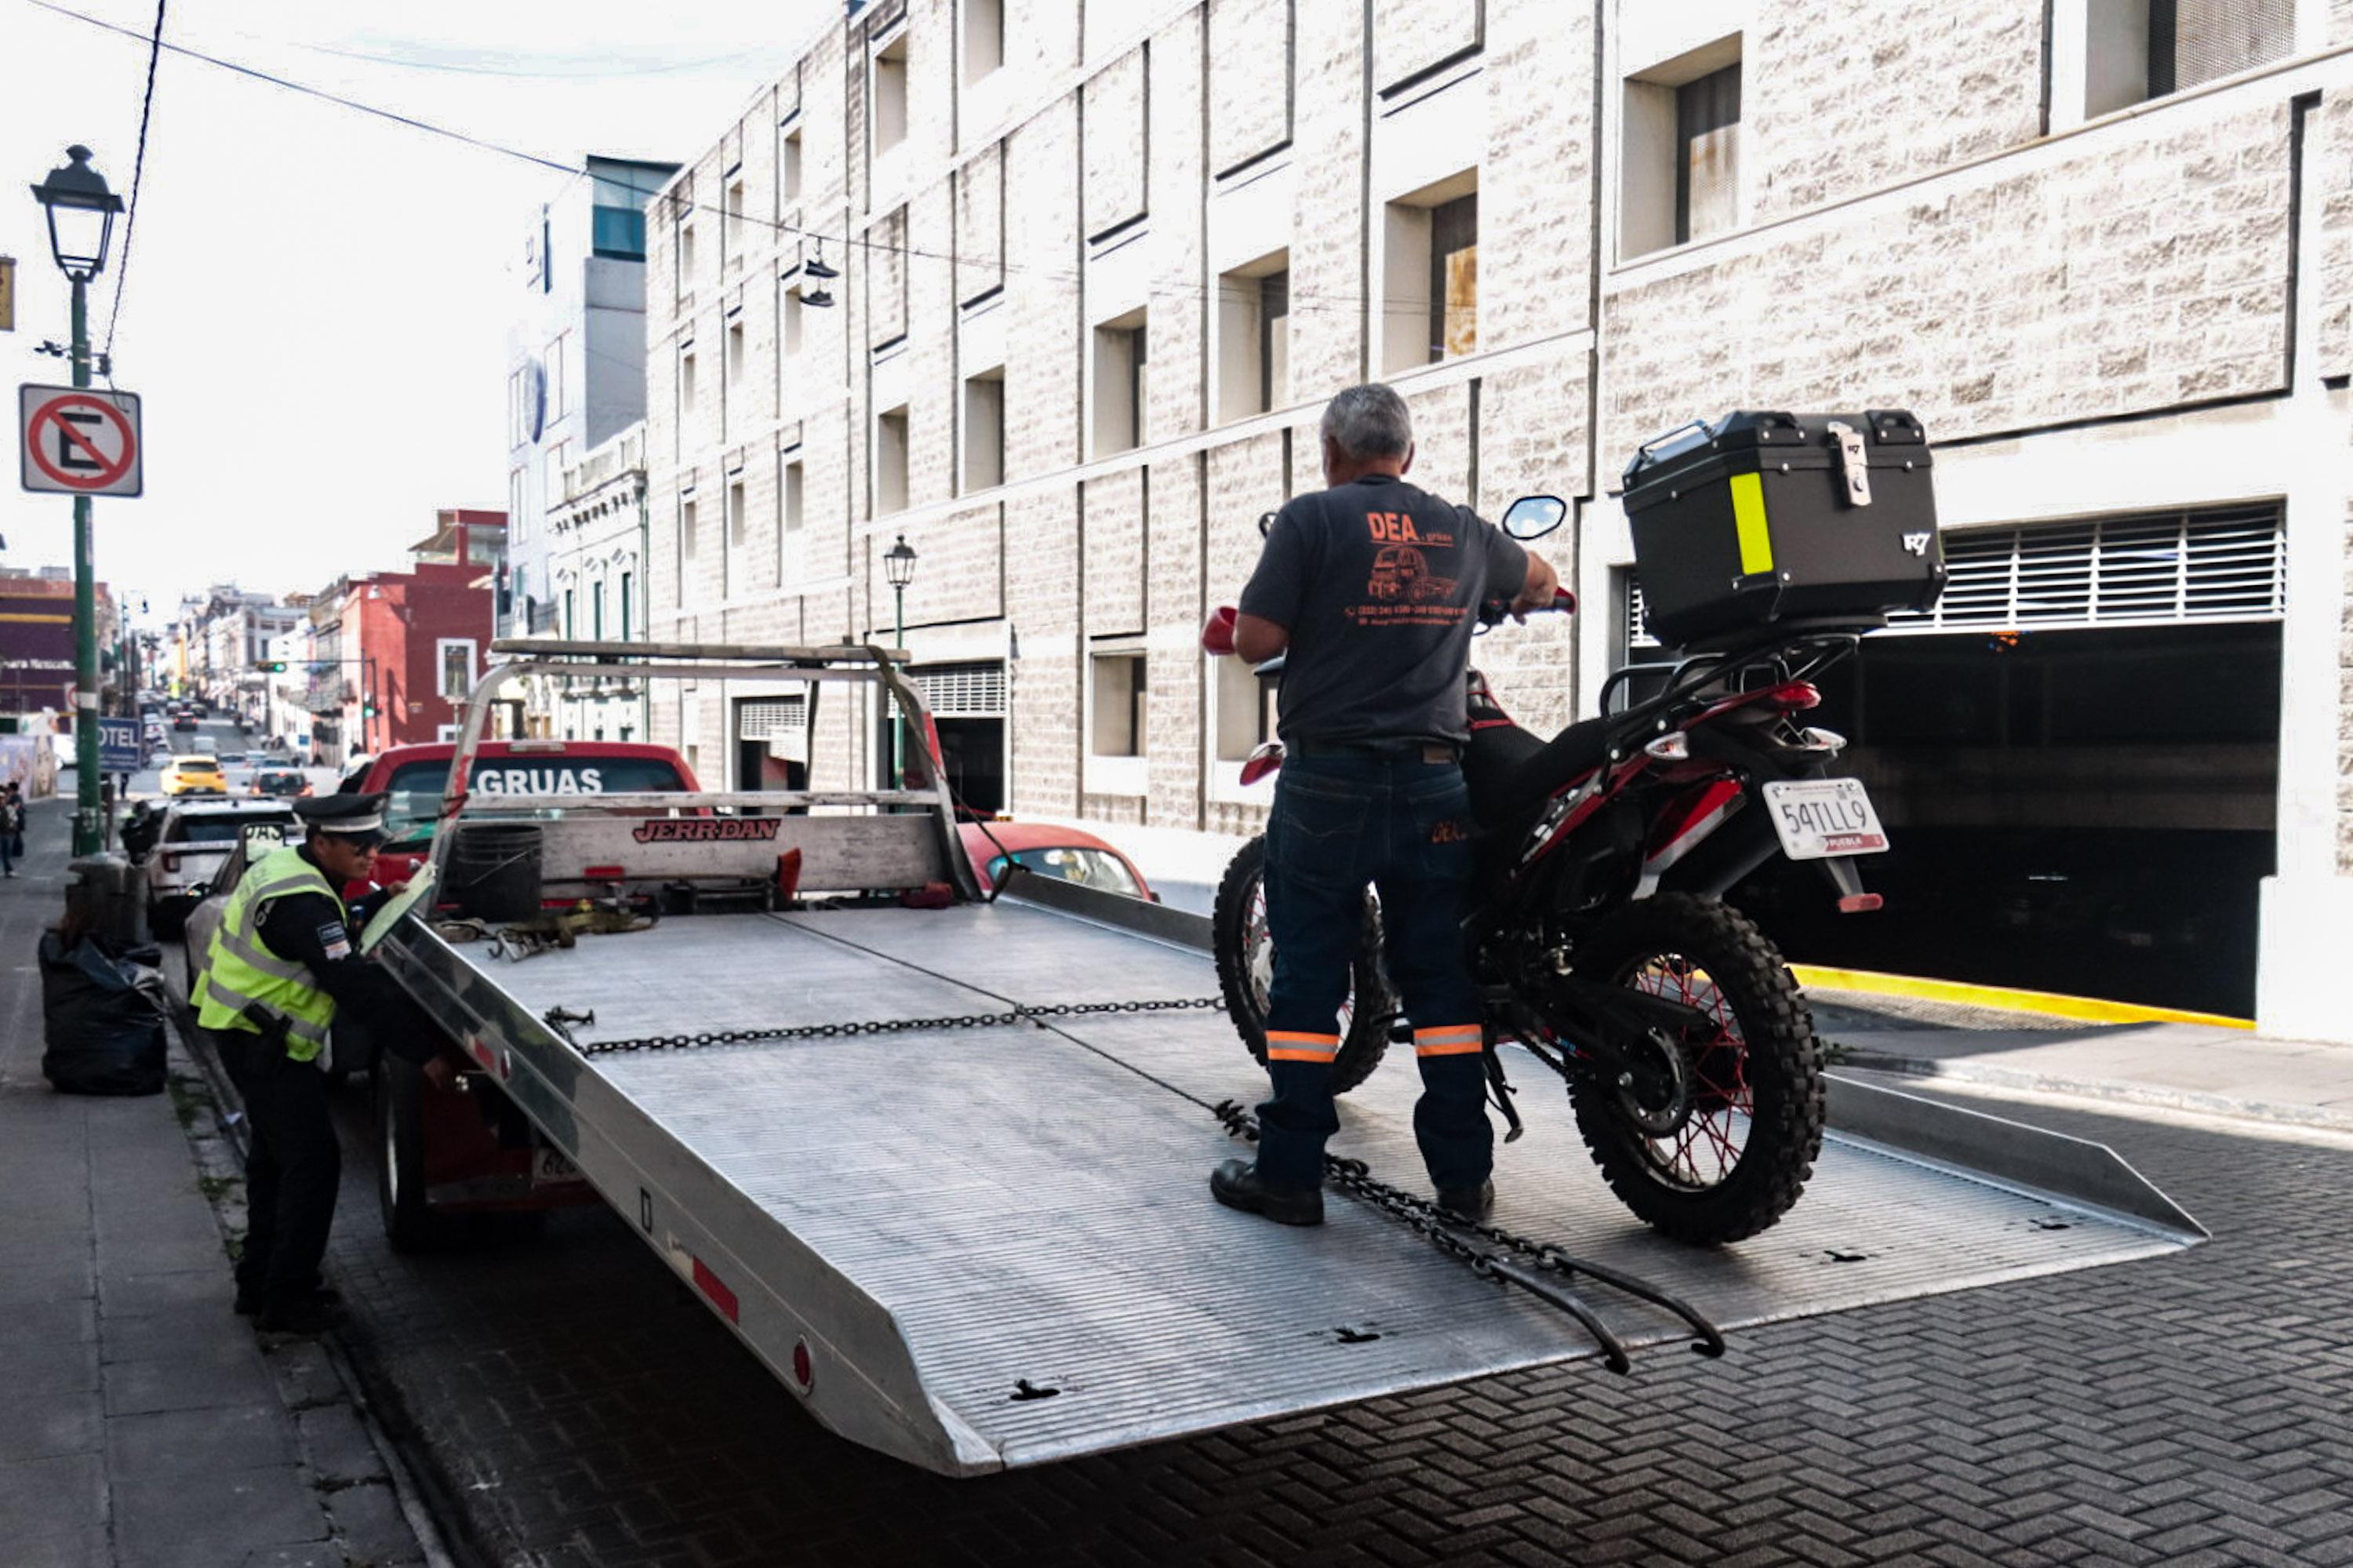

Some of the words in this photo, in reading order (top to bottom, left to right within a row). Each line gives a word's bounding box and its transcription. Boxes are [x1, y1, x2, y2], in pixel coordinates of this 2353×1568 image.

[1367, 511, 1419, 542] DEA
[1901, 532, 1932, 556] R7
[477, 768, 603, 796] GRUAS
[1781, 800, 1867, 833] 54TLL9
